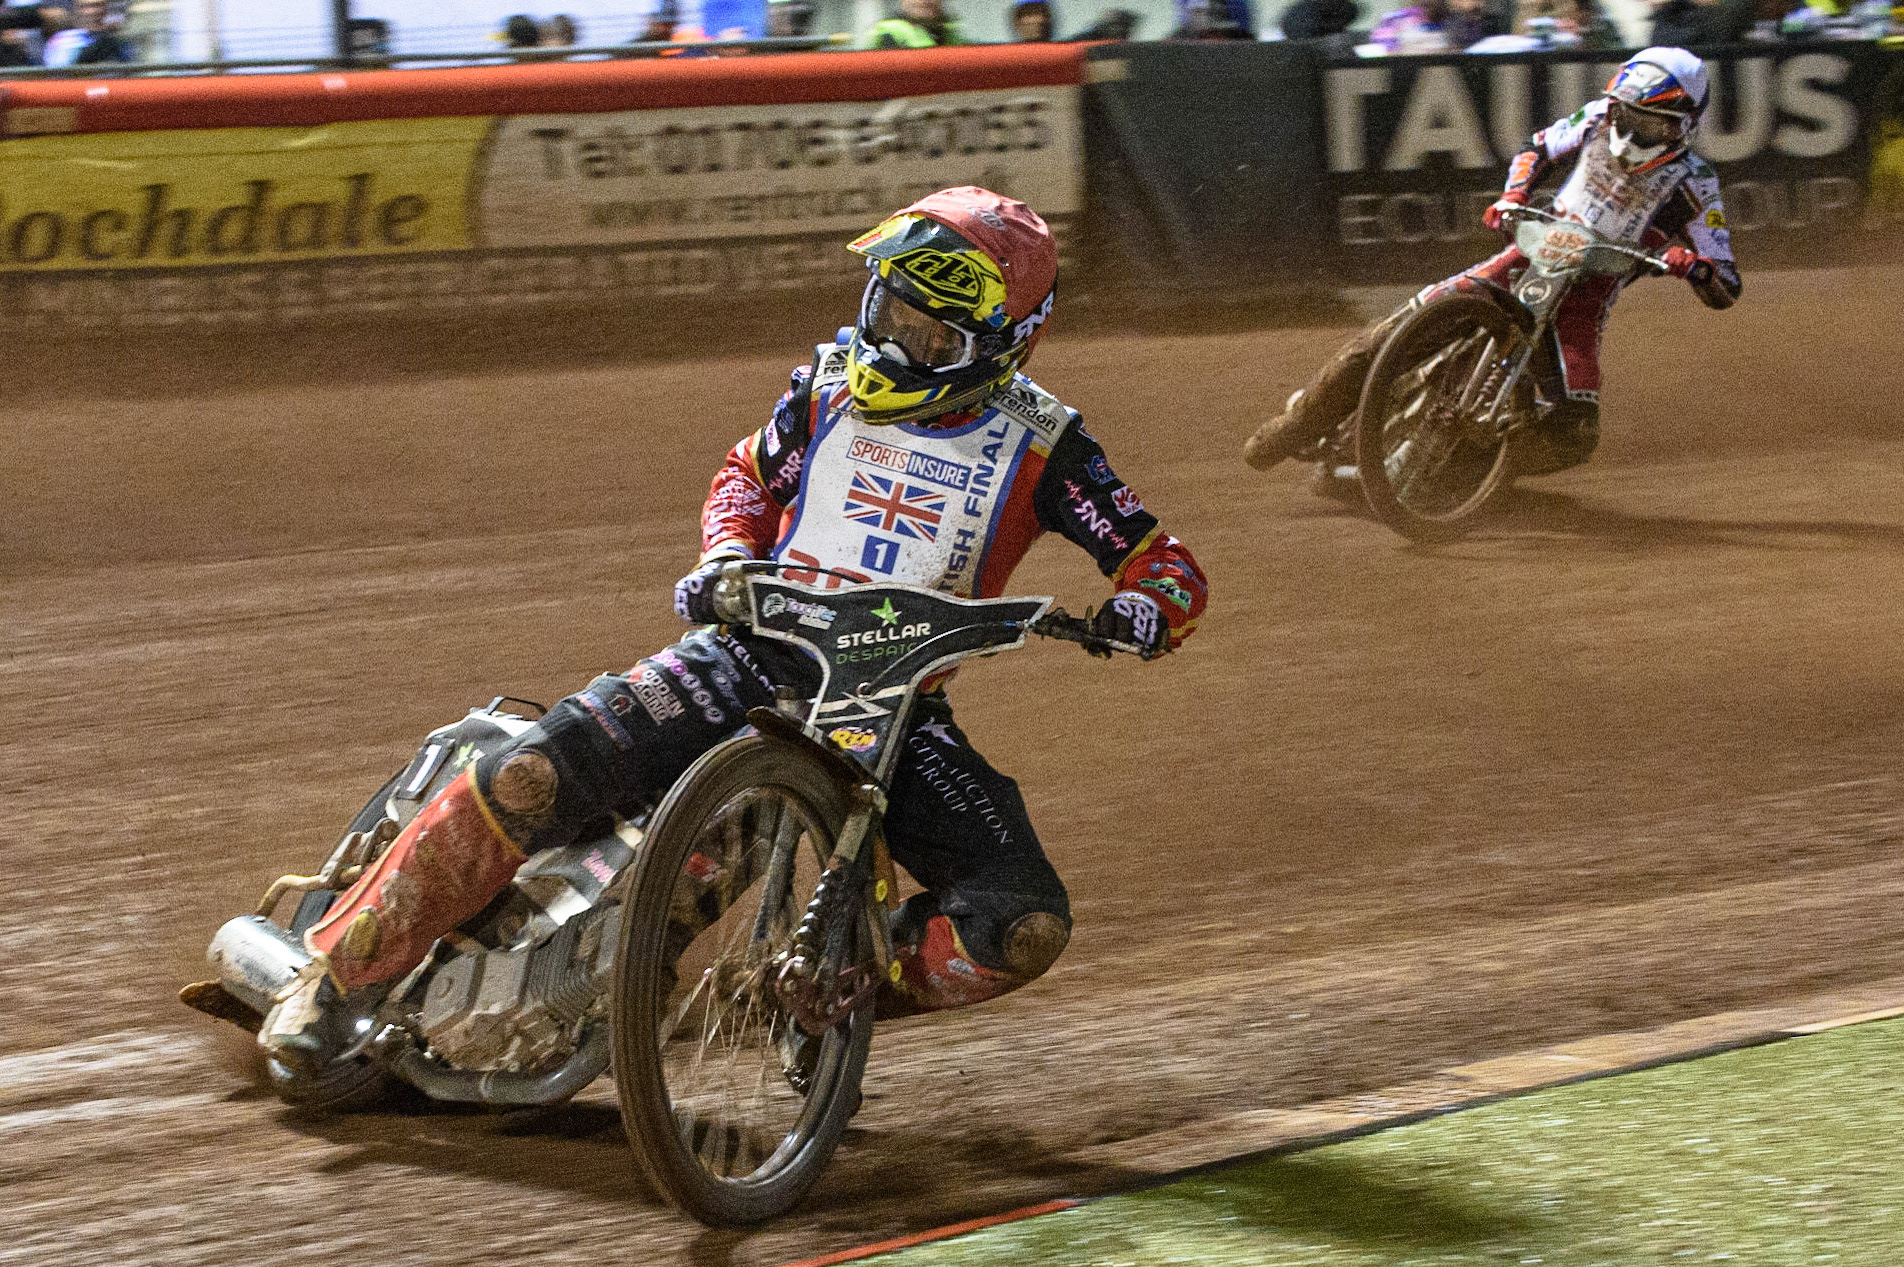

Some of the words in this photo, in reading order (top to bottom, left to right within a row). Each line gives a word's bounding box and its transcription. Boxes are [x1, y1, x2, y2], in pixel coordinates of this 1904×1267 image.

[1322, 54, 1858, 171] TAUUS
[2, 171, 432, 265] ochdale
[939, 528, 977, 593] TISH
[964, 421, 1010, 519] FINAL
[874, 542, 889, 570] 1
[836, 622, 931, 649] STELLAR
[836, 642, 918, 665] DESPATC
[407, 744, 442, 792] 1
